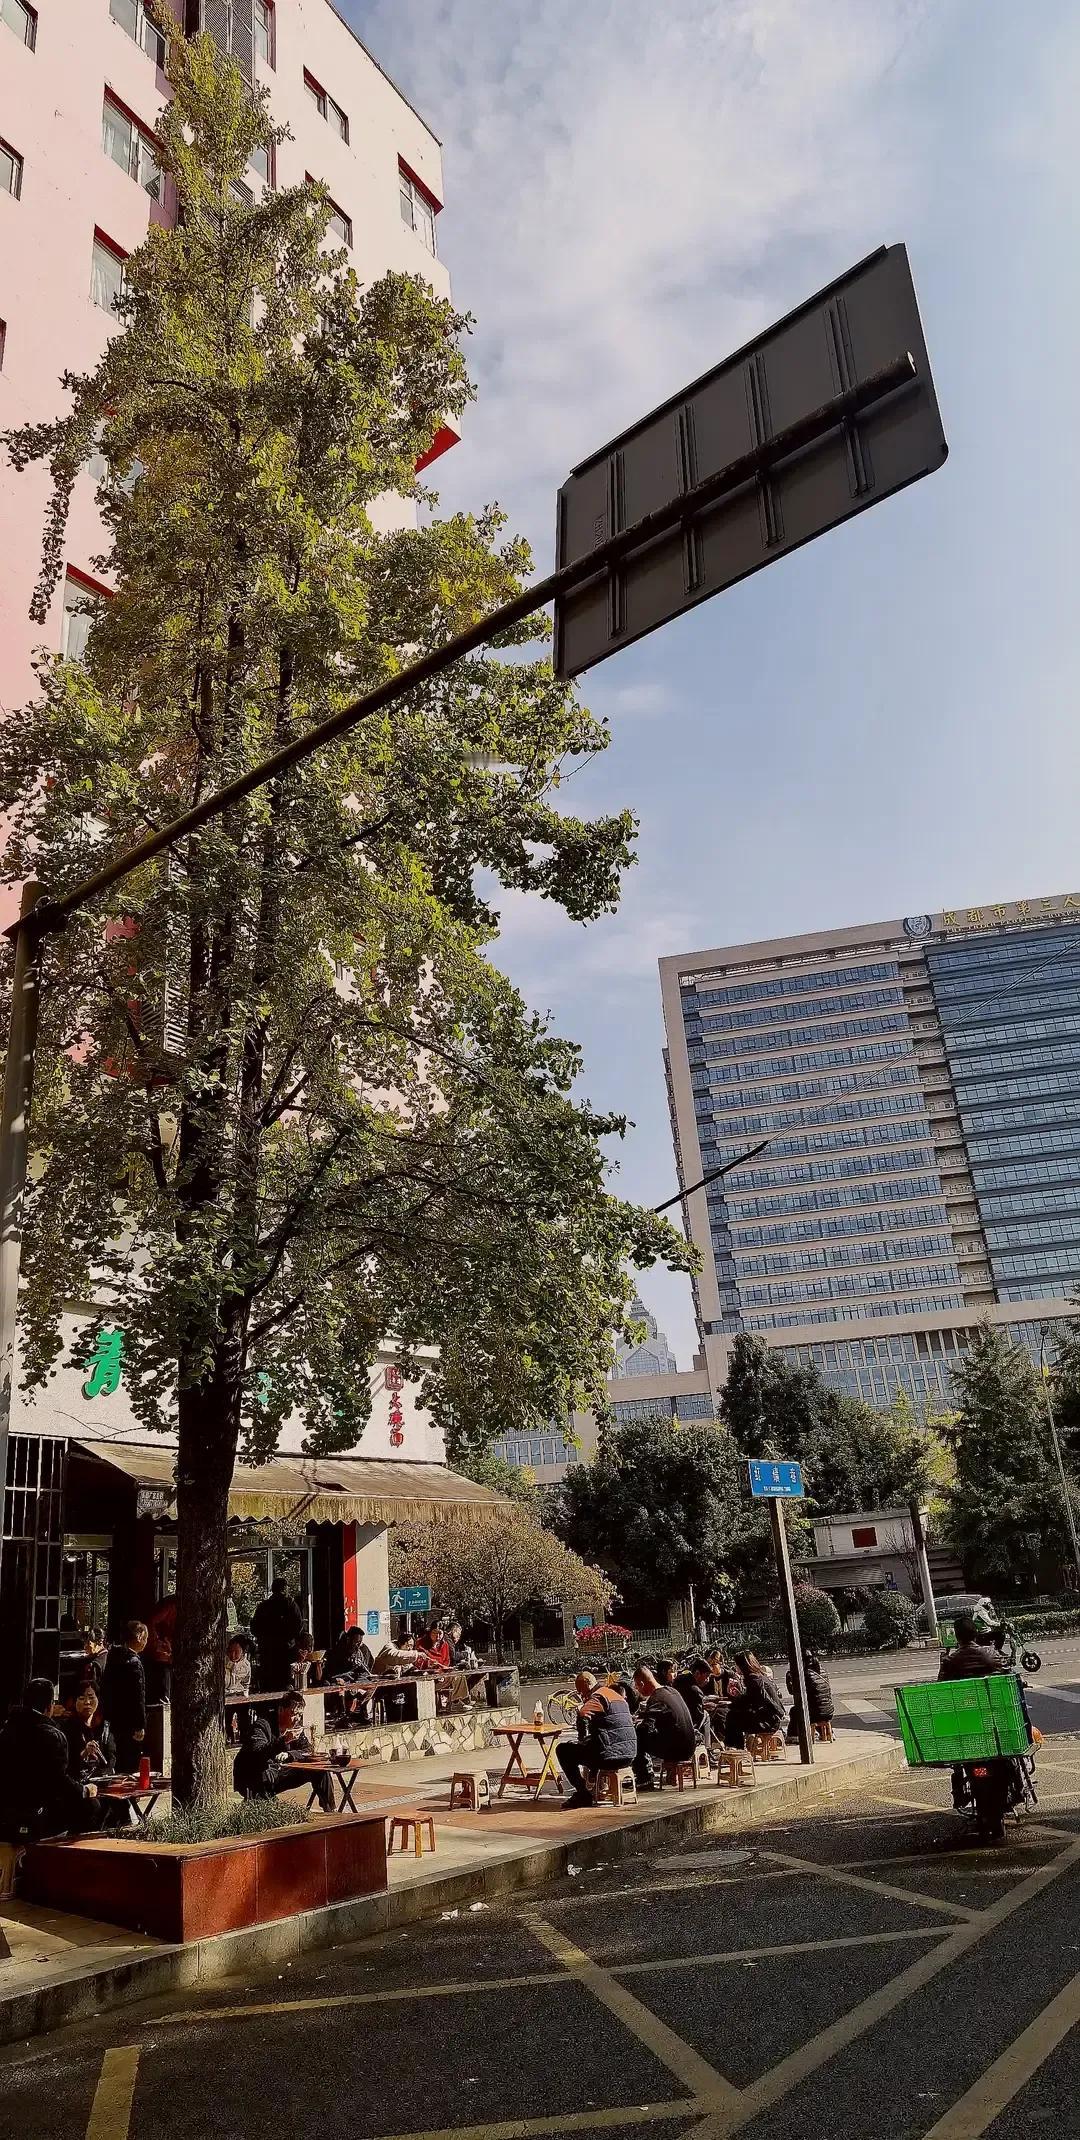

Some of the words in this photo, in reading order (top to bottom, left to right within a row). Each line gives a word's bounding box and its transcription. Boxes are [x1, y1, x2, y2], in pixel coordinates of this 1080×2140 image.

[943, 895, 1080, 926] 成都市第三人
